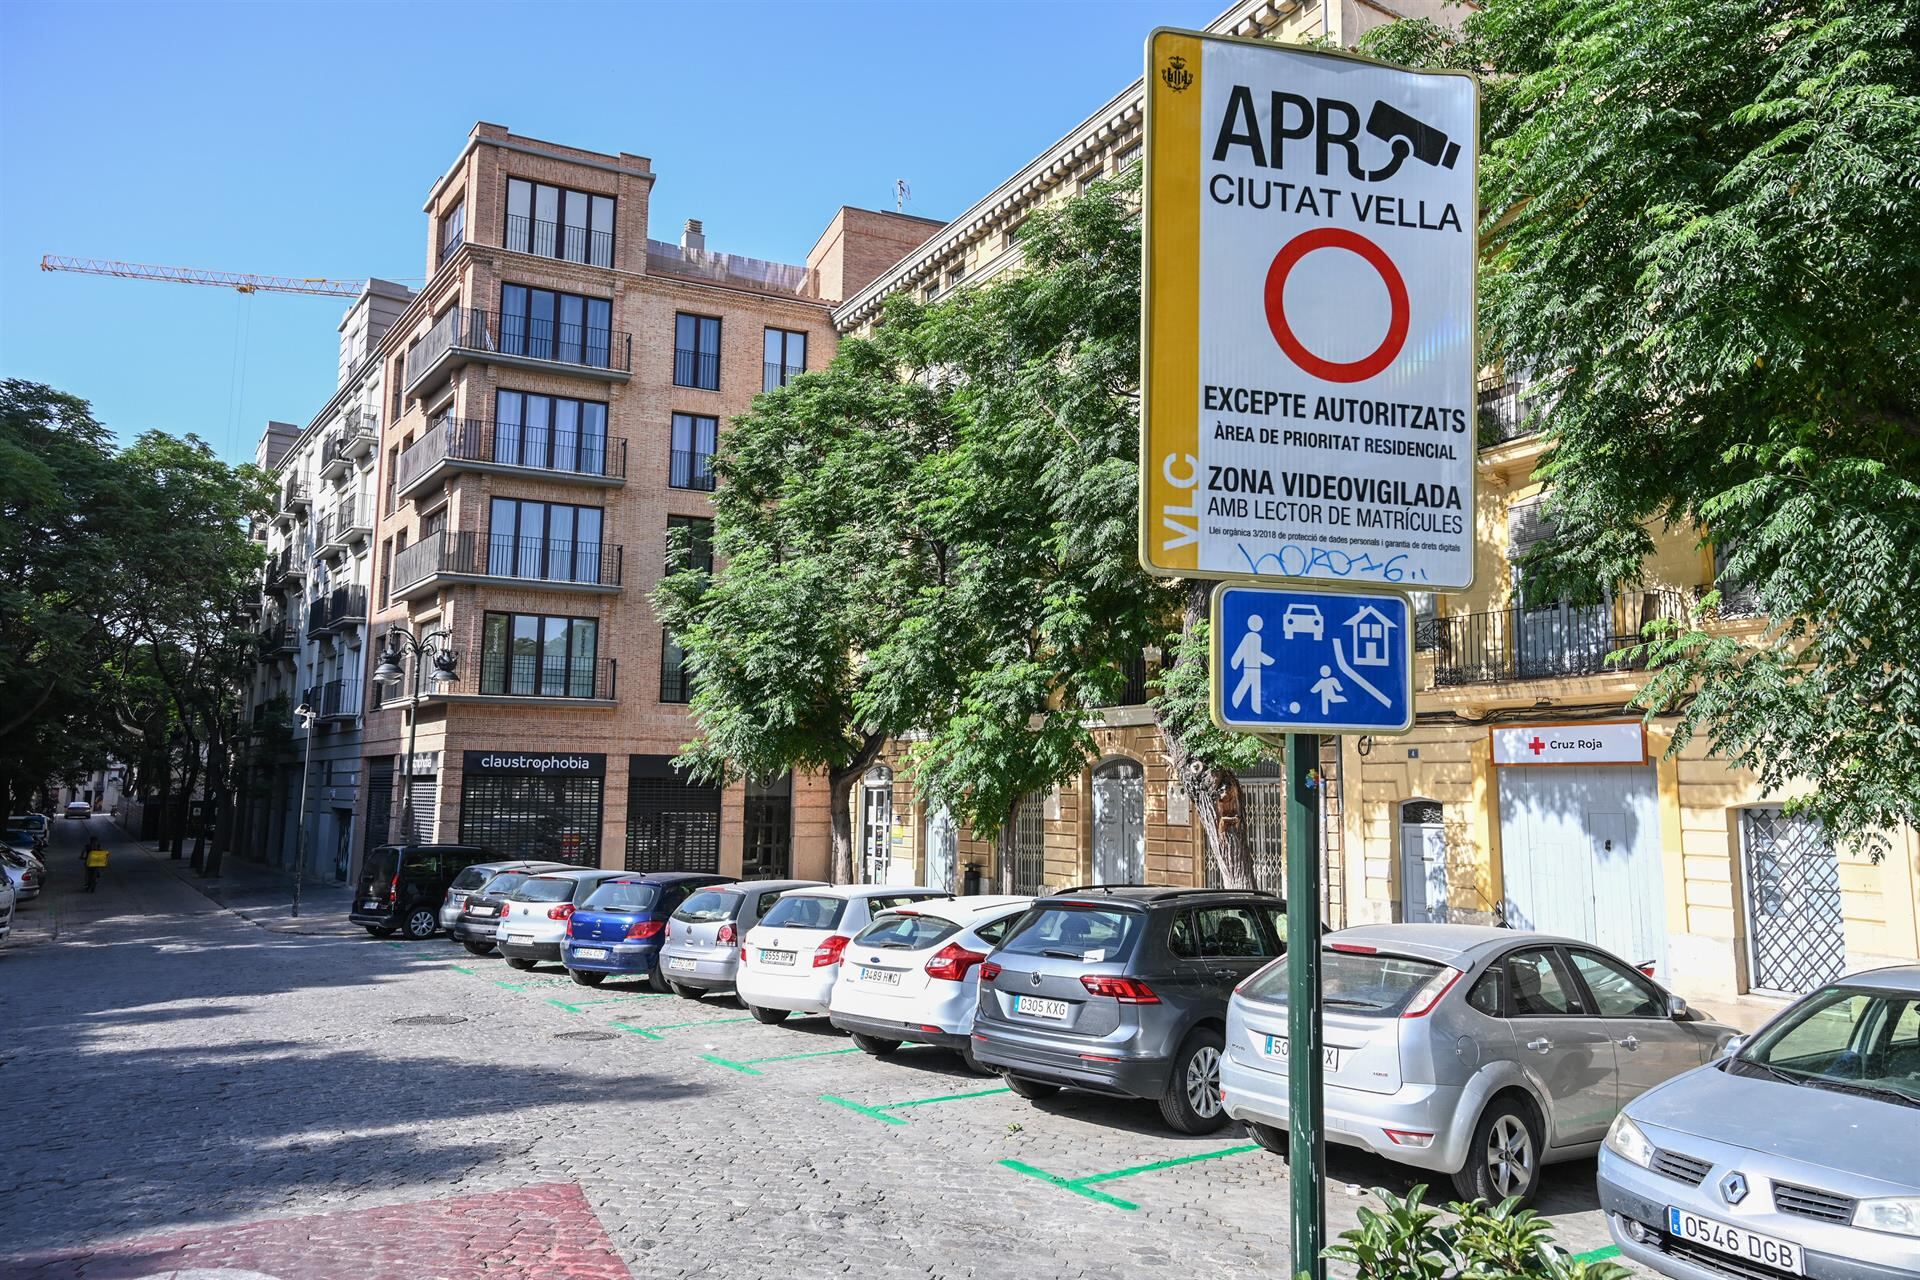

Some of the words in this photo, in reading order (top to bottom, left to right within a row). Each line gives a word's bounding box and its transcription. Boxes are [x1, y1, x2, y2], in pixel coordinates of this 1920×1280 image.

[1212, 85, 1366, 182] APR
[1209, 174, 1341, 218] CIUTAT
[1351, 192, 1463, 233] VELLA
[1204, 385, 1306, 419] EXCEPTE
[1314, 396, 1466, 433] AUTORITZATS
[1214, 420, 1255, 442] ÀREA
[1259, 428, 1279, 445] DE
[1283, 430, 1361, 452] PRIORITAT
[1364, 437, 1457, 460] RESIDENCIAL
[1162, 453, 1198, 551] VLC
[1207, 465, 1275, 495] ZONA
[1281, 472, 1462, 510] VIDEOVIGILADA
[1207, 496, 1248, 518] AMB
[1254, 500, 1322, 524] LECTOR
[1328, 506, 1351, 526] DE
[1356, 507, 1463, 534] MATRÍCULES
[1252, 529, 1277, 539] 3/2018
[1278, 531, 1286, 539] de
[1288, 533, 1318, 542] protecció
[1319, 534, 1328, 543] de
[1328, 535, 1349, 544] dades
[1349, 537, 1380, 546] personals
[1411, 541, 1420, 549] de
[1421, 542, 1438, 550] drets
[1438, 543, 1461, 552] digitals
[481, 754, 590, 772] claustrophobia
[1550, 740, 1575, 750] Cruz
[1578, 738, 1603, 750] Roja
[765, 950, 779, 961] 8555
[865, 969, 882, 981] 3489
[883, 972, 898, 984] HWC
[1046, 1001, 1066, 1016] KXG
[1685, 1216, 1739, 1252] 0546
[1748, 1234, 1794, 1268] DGB
